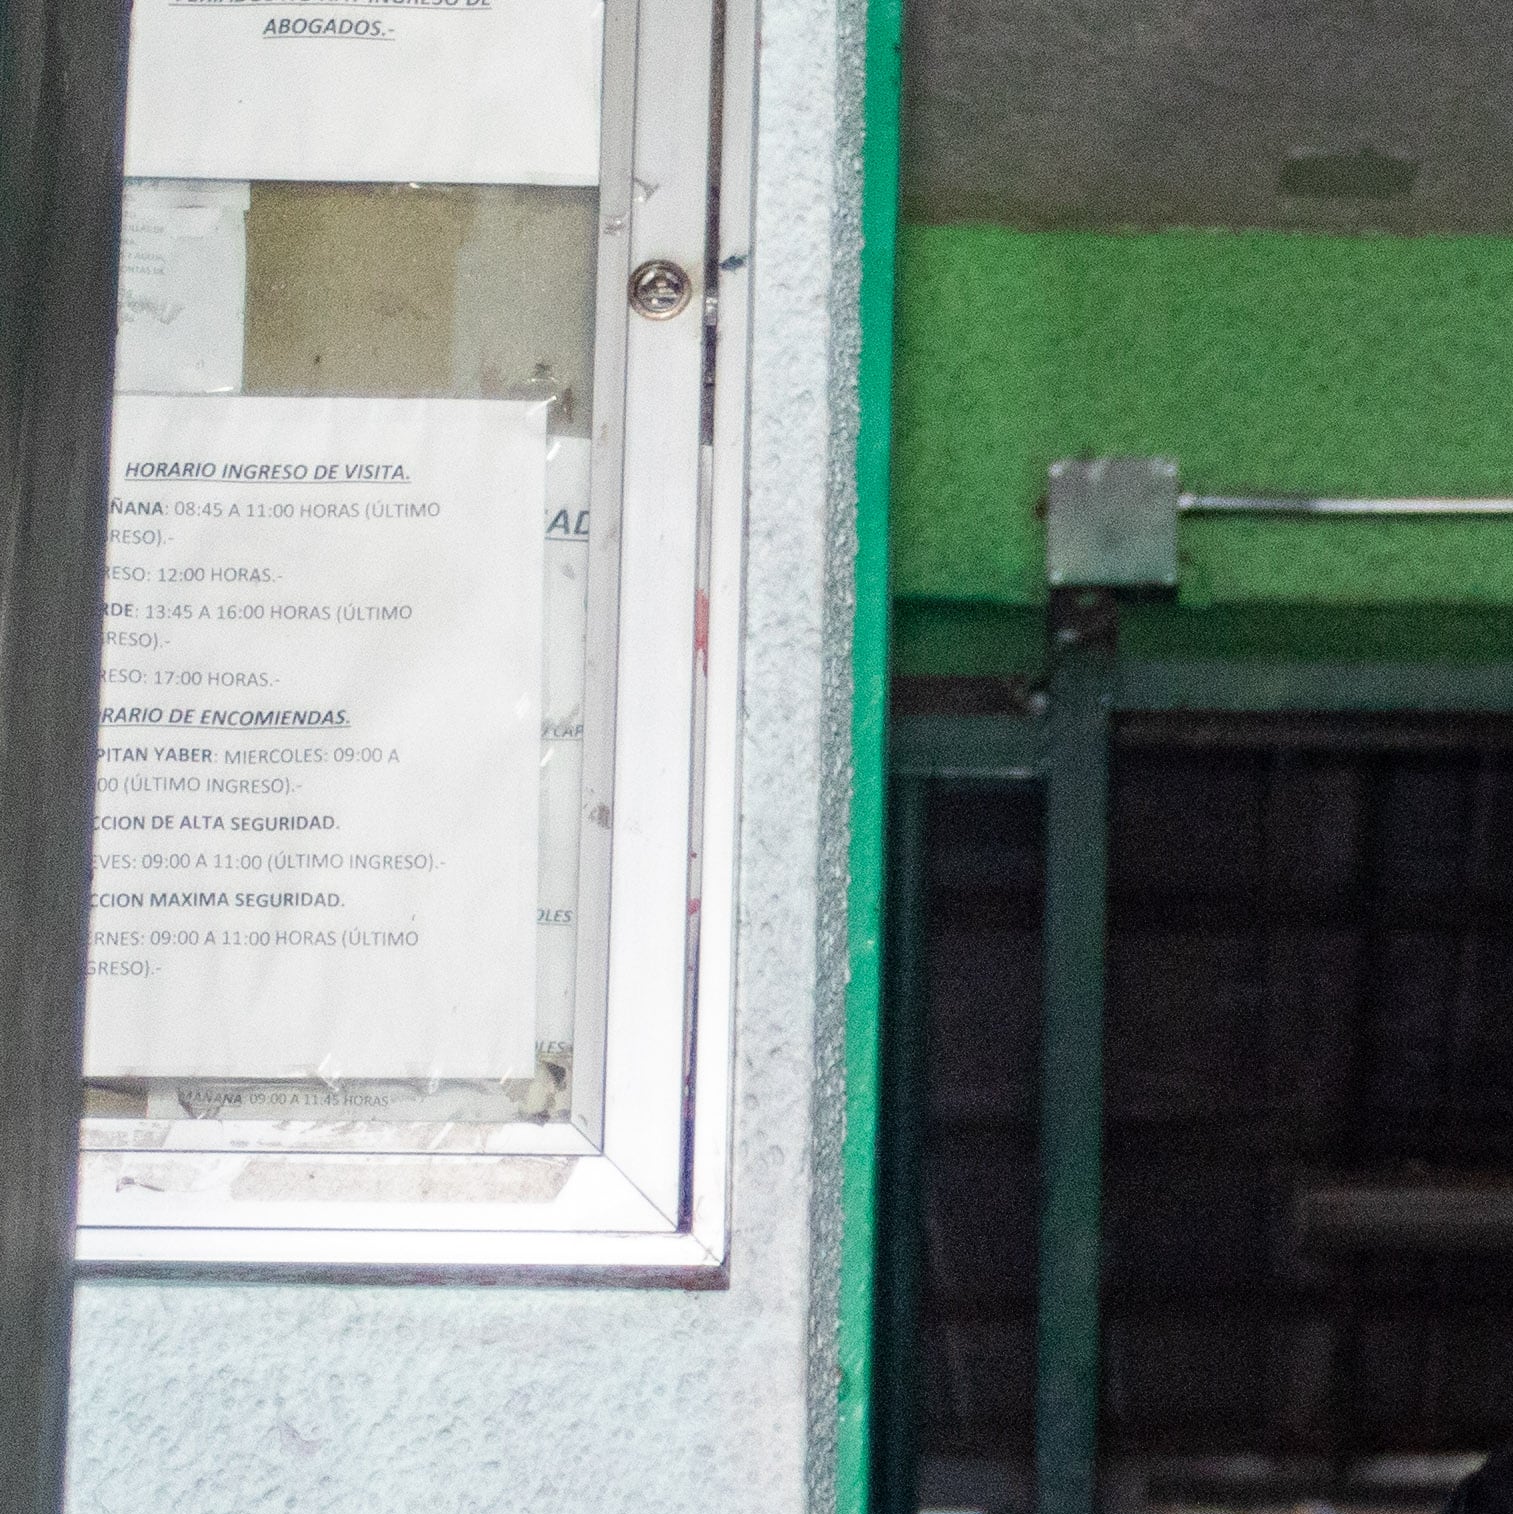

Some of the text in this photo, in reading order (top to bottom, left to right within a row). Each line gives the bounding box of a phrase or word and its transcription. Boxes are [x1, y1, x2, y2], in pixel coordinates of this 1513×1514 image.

[262, 18, 395, 37] ABOGADOS.-
[125, 462, 411, 480] HORARIO INGRESO DE VISITA.
[109, 497, 441, 519] ÑANA: 08:45 A 11:00 HORAS (ÚLTIMO
[108, 529, 175, 547] RESO).-
[103, 566, 283, 583] RESO: 12:00 HORAS.-
[100, 603, 413, 624] RDE: 13:45 A 16:00 HORAS (ÚLTIMO
[104, 631, 171, 651] RESO).-
[100, 668, 281, 687] RESO: 17:00 HORAS.-
[101, 707, 351, 726] RARIO DE ENCOMIENDAS.
[95, 747, 400, 764] PITAN YABER: MIERCOLES: 09:00 A
[96, 773, 303, 795] 00 (ÚLTIMO INGRESO).-
[93, 815, 340, 832] CCION DE ALTA SEGURIDAD.
[141, 853, 191, 869] 09:00
[195, 853, 208, 868] A
[213, 853, 262, 870] 11:00
[267, 851, 344, 872] (ÚLTIMO
[350, 853, 447, 872] INGRESO).-
[90, 892, 345, 908] CCION MAXIMA SEGURIDAD.
[91, 927, 419, 949] RNES: 09:00 A 11:00 HORAS (ÚLTIMO
[86, 960, 162, 979] GRESO).-
